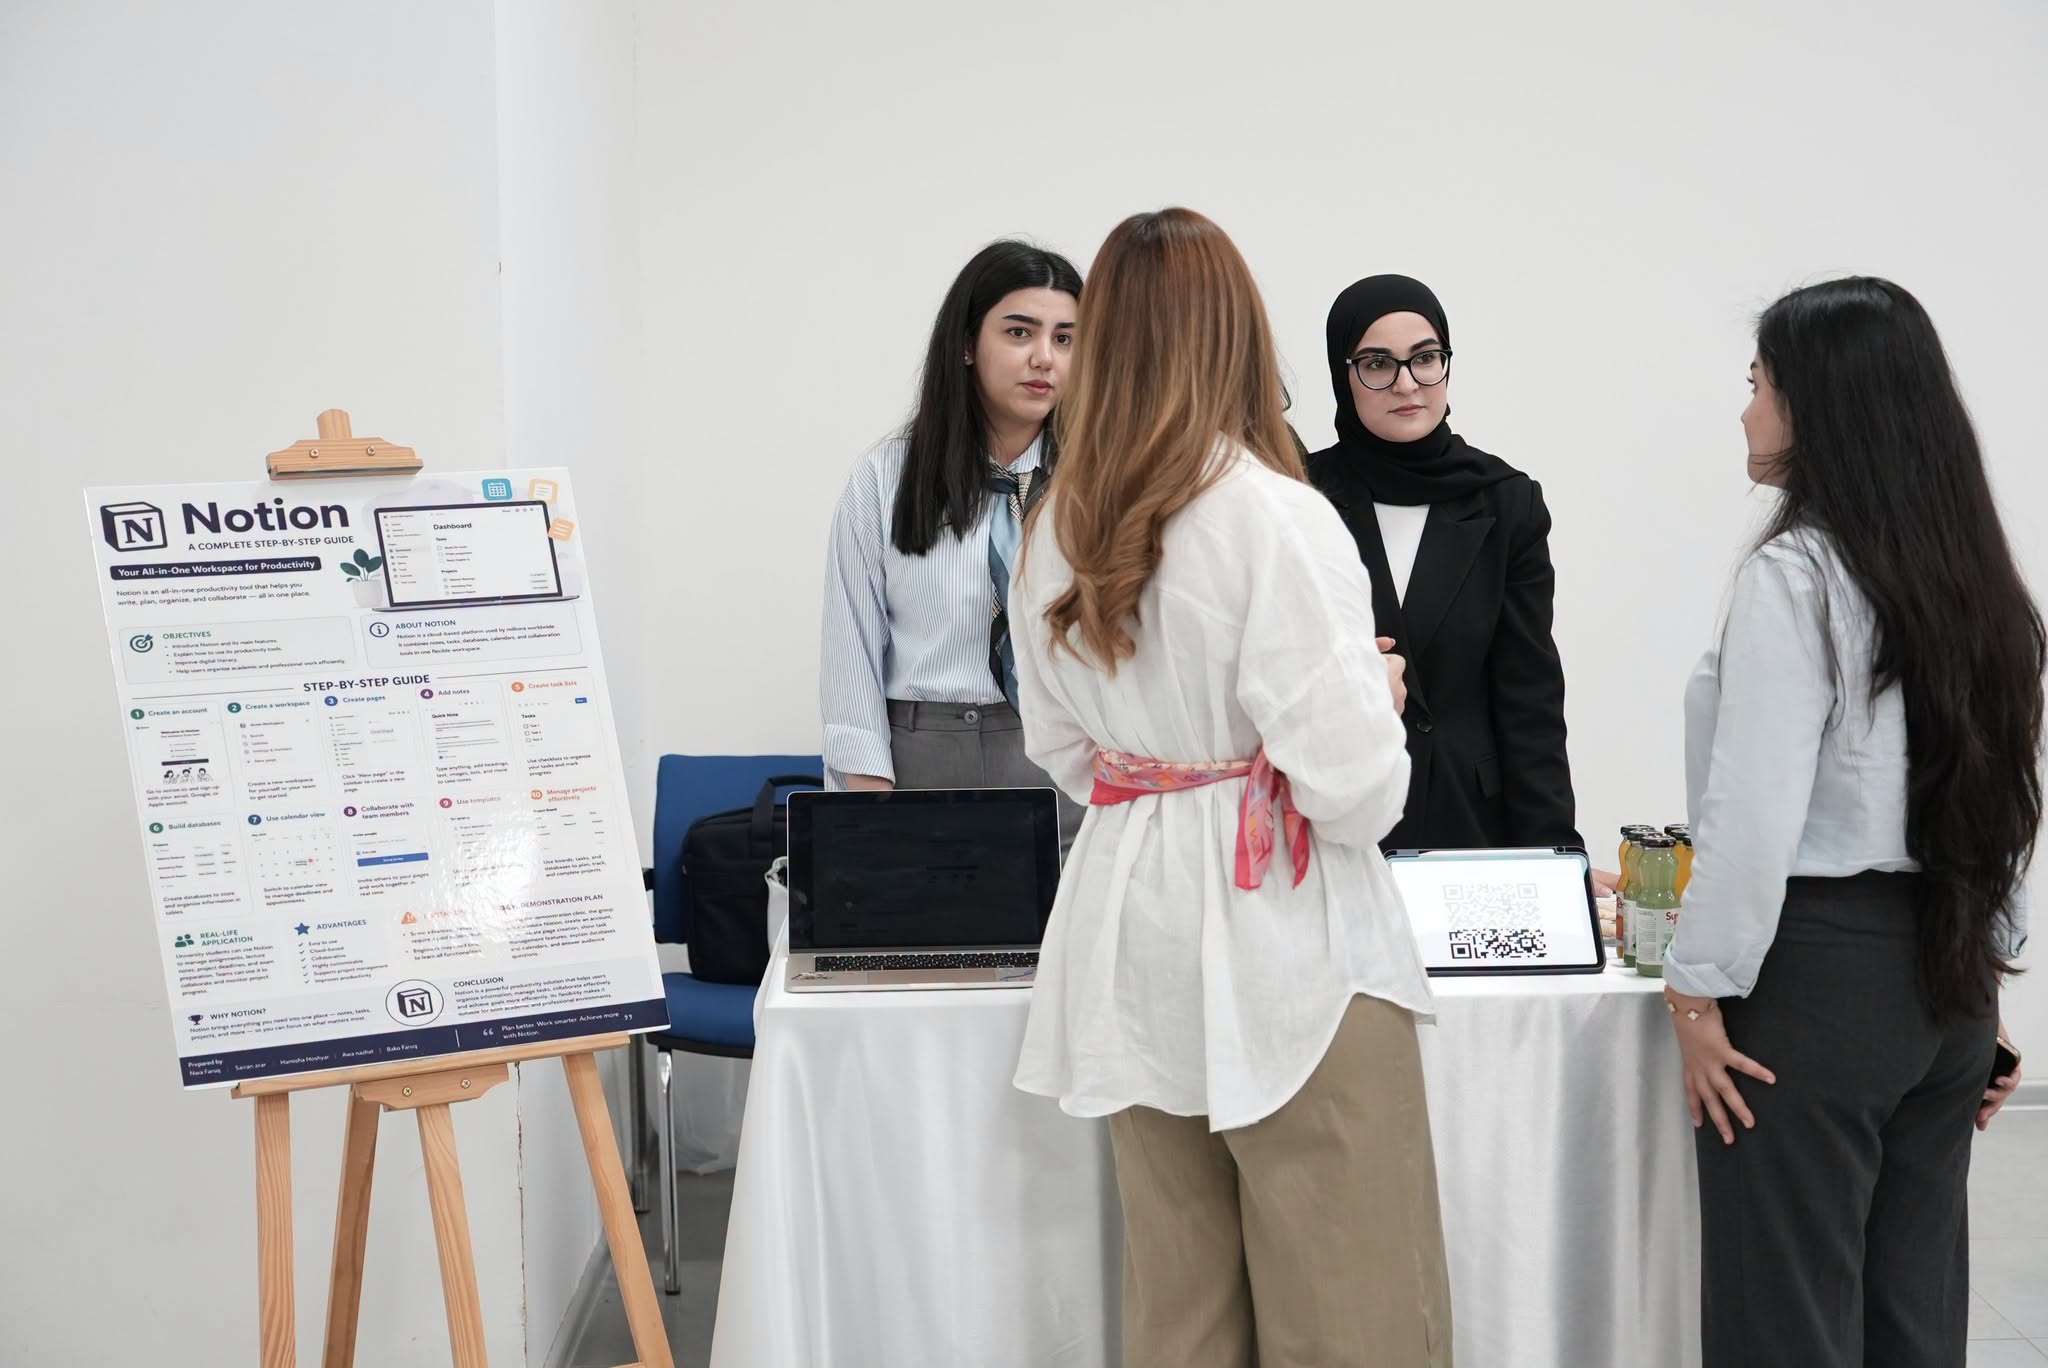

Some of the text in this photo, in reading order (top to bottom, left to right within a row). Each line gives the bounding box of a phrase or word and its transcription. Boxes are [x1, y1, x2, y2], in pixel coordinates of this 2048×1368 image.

[181, 497, 350, 535] Notion
[122, 517, 154, 544] N
[433, 522, 472, 530] Dashboard
[188, 535, 355, 551] A COMPLETE STEP-BY-STEP GUIDE
[117, 560, 315, 577] Your All-in-One Workspace for Productivity
[196, 586, 238, 594] productivity
[139, 598, 158, 606] plan,
[158, 597, 192, 605] organize,
[207, 594, 247, 602] collaborate
[290, 591, 310, 599] place.
[395, 619, 456, 630] ABOUT NOTION
[162, 631, 212, 640] OBJECTIVES
[303, 674, 430, 692] STEP-BY-STEP GUIDE
[366, 695, 386, 703] pages
[181, 707, 208, 715] account
[571, 786, 597, 794] projects
[547, 794, 581, 803] effectively
[360, 804, 399, 812] Collaborate
[280, 813, 309, 821] calendar
[187, 821, 221, 829] databases
[521, 896, 583, 908] DEMONSTRATION
[583, 894, 604, 902] PLAN
[316, 919, 367, 930] ADVANTAGES
[199, 929, 238, 939] REAL-LIFE
[201, 936, 253, 946] APPLICATION
[453, 976, 504, 988] CONCLUSION
[410, 997, 426, 1013] N
[209, 1008, 267, 1020] WHY NOTION?
[579, 1014, 603, 1022] Achieve
[187, 1059, 215, 1068] Prepared
